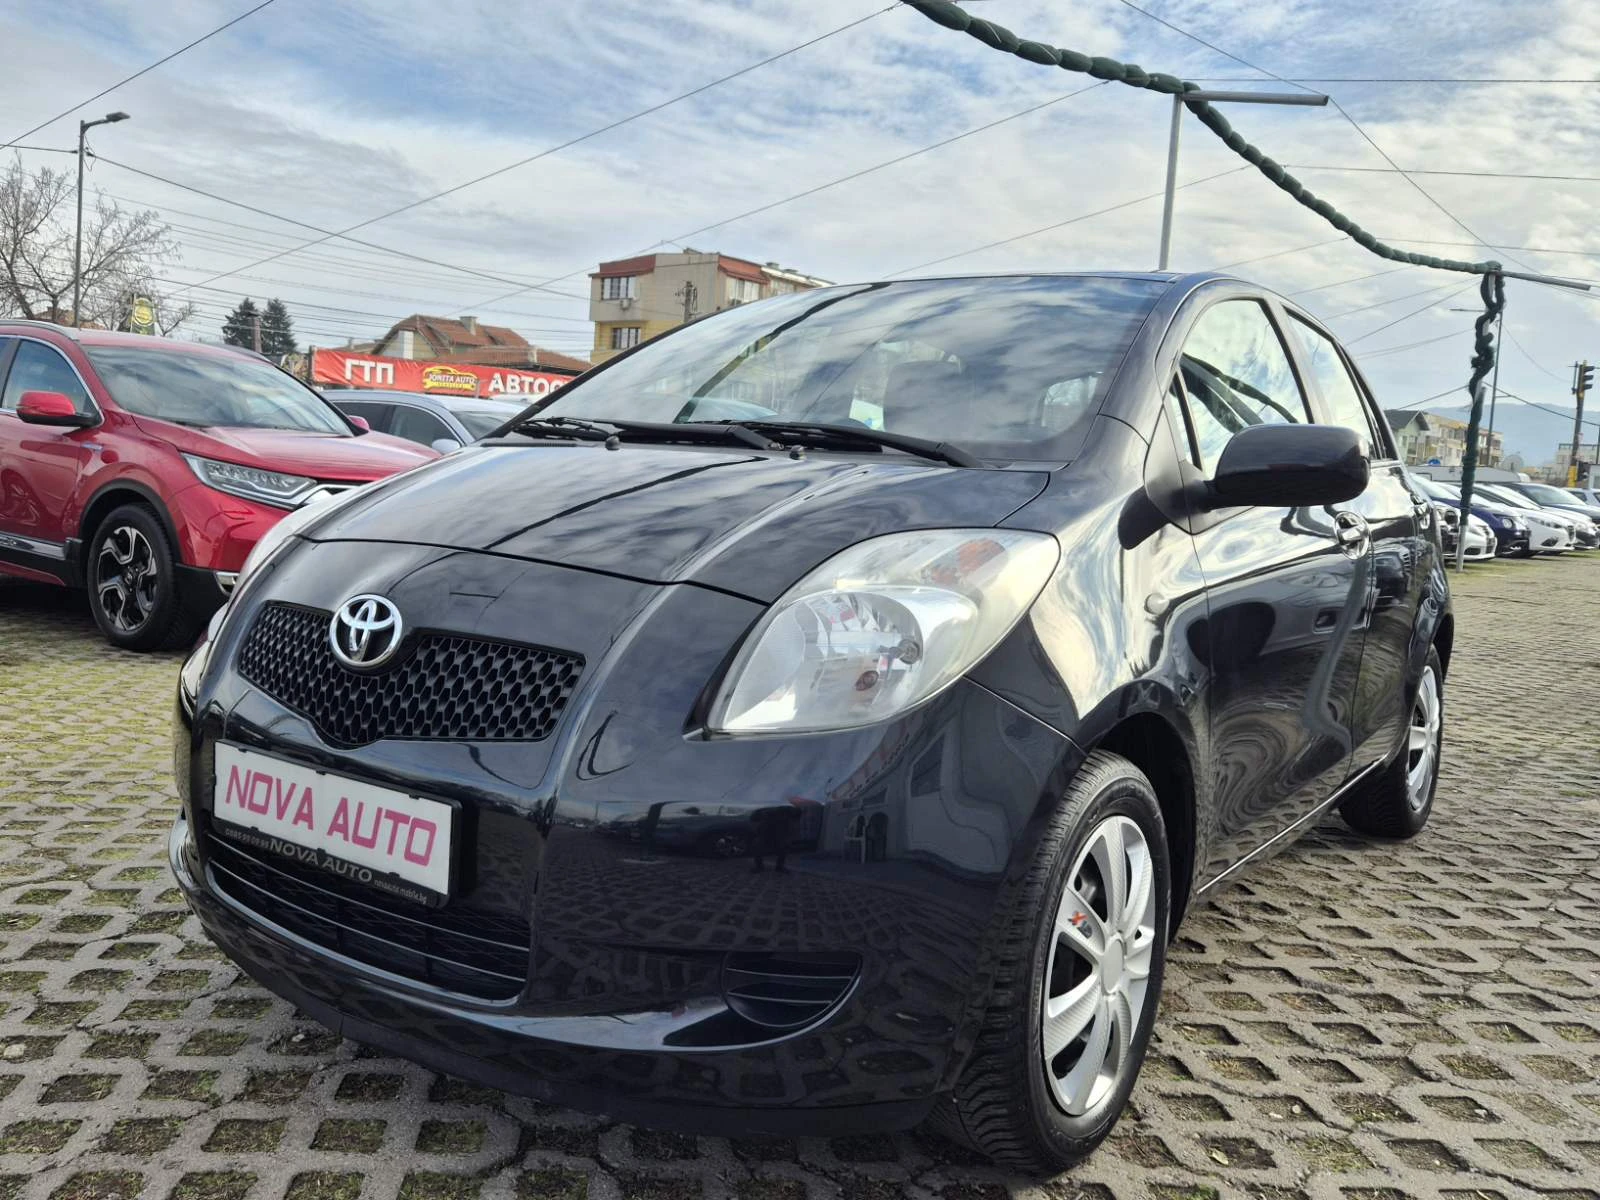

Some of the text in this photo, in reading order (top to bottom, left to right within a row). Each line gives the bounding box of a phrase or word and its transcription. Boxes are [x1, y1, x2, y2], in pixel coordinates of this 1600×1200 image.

[345, 359, 394, 385] ГТП
[455, 375, 477, 385] AUTO
[488, 372, 569, 395] АВТОС
[225, 765, 437, 867] NOVA AUTO
[270, 838, 319, 865] NOVA
[322, 856, 372, 882] AUTO
